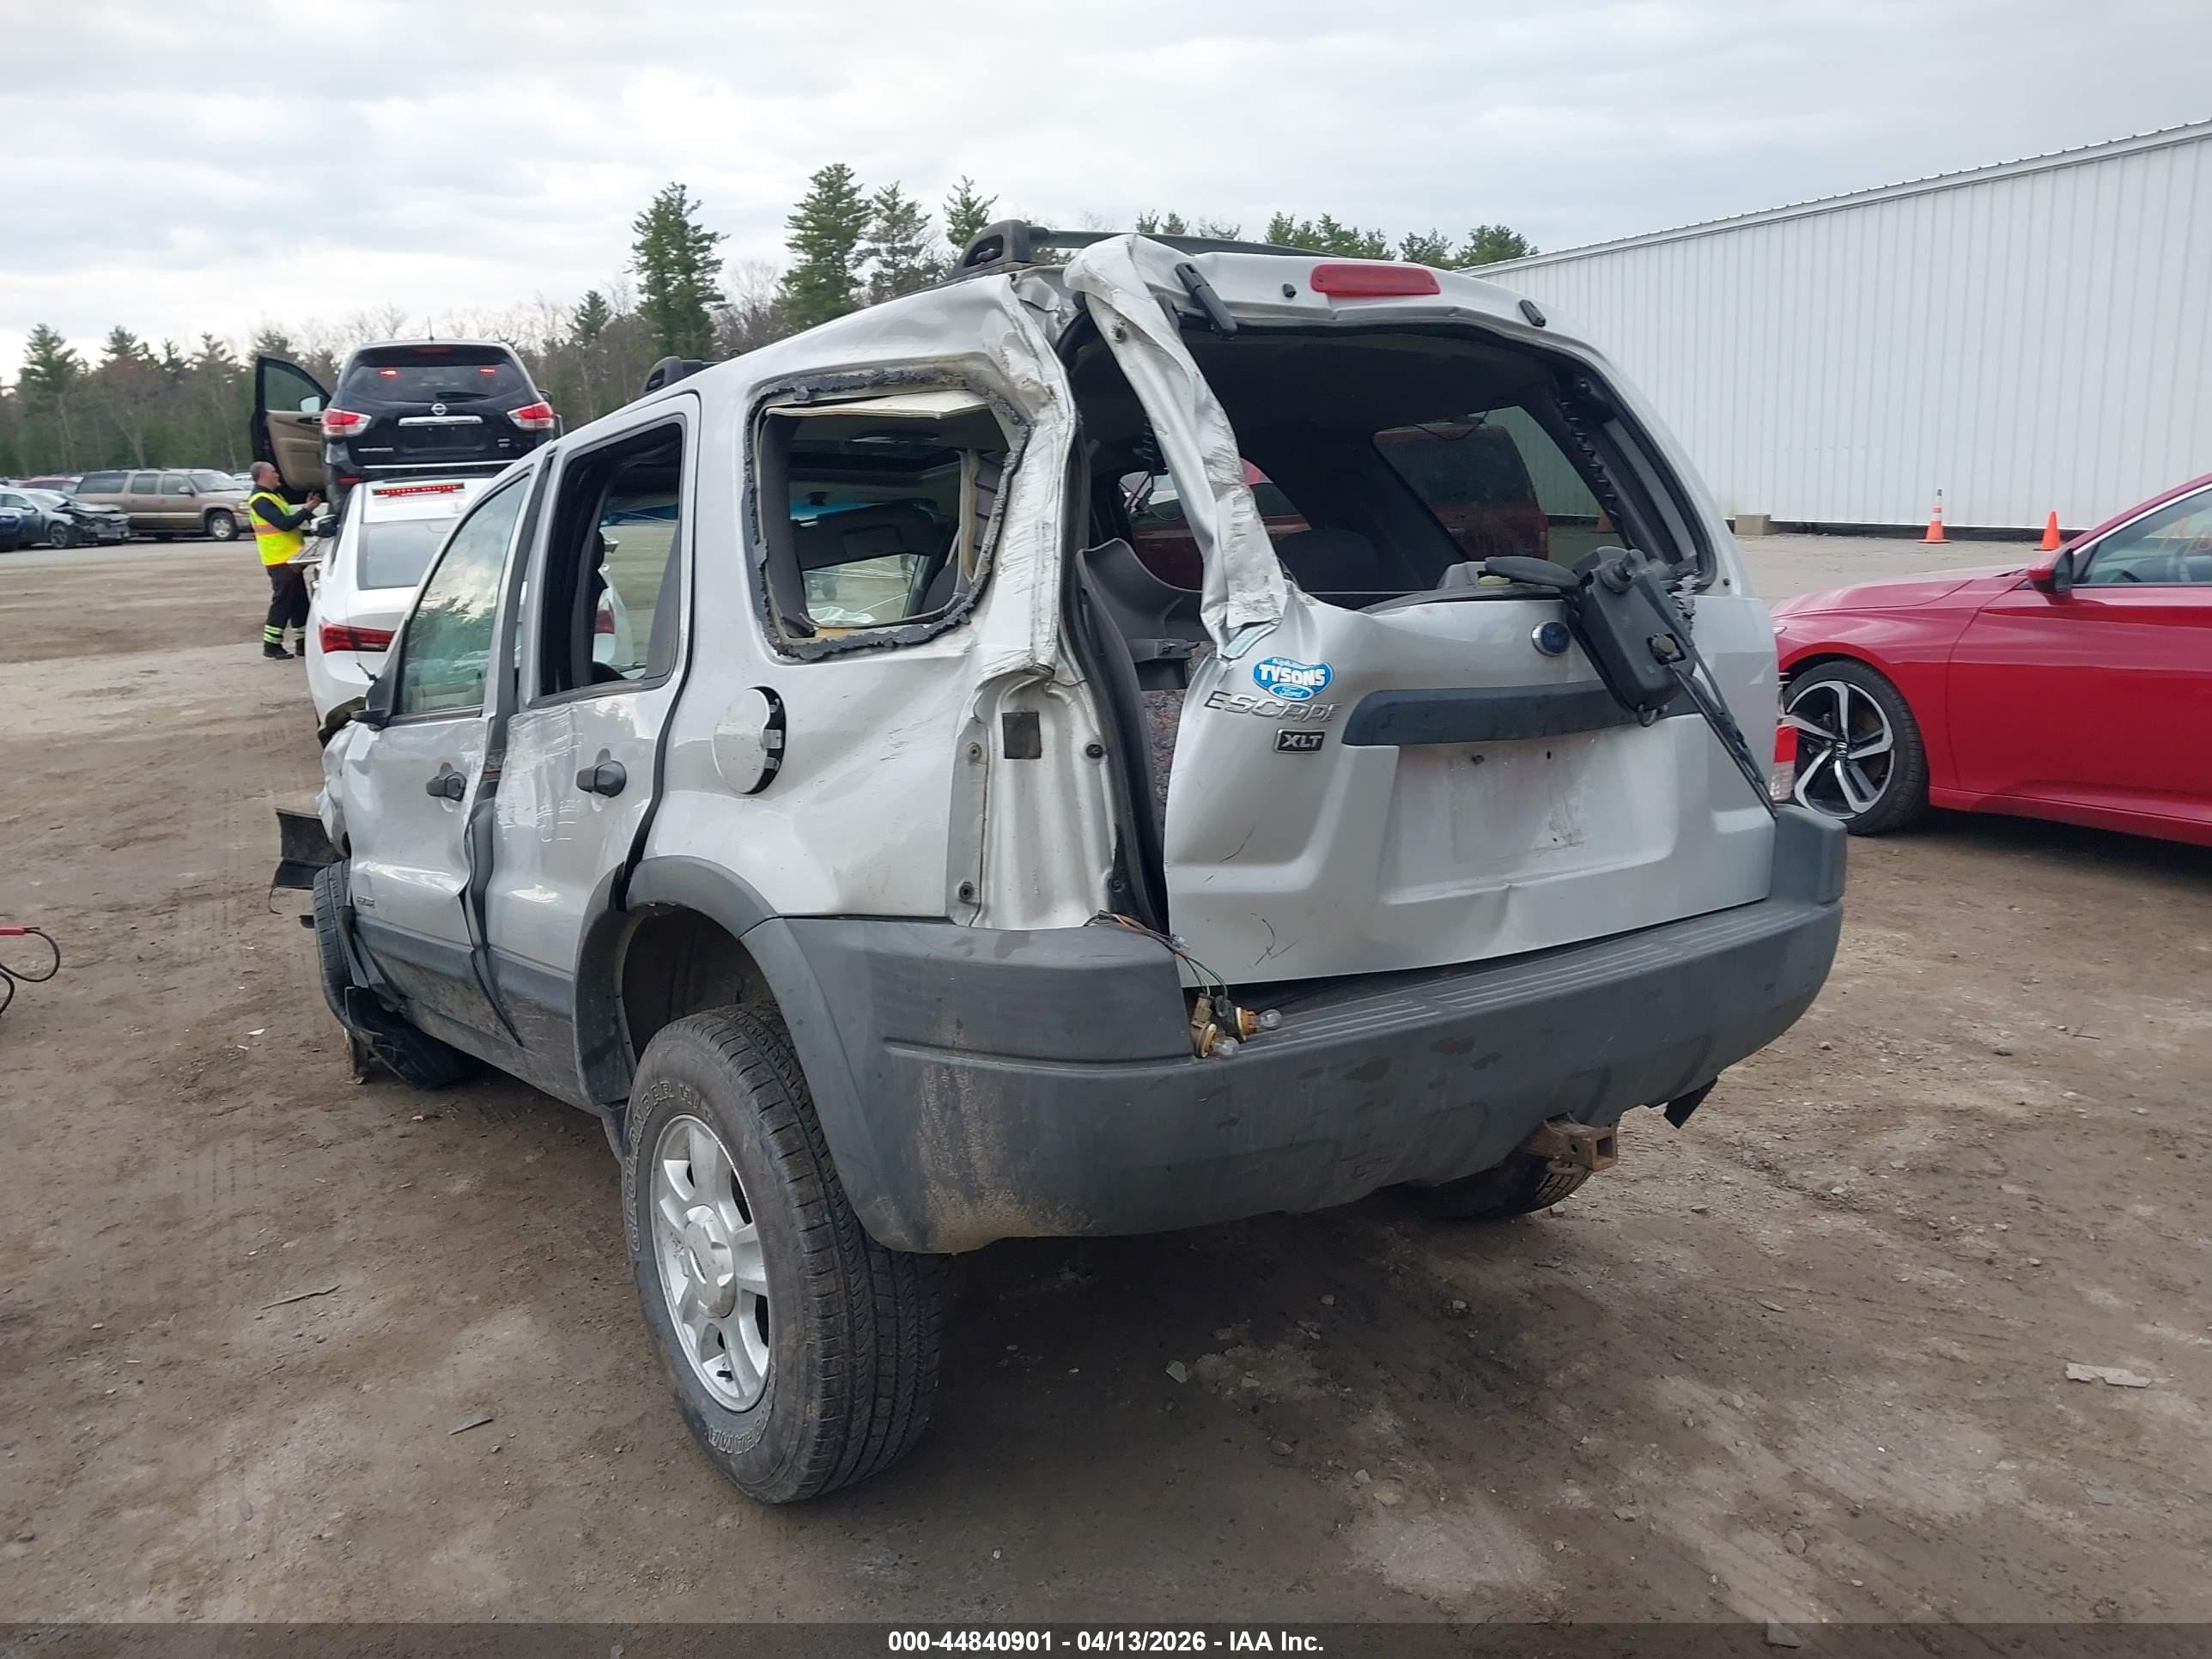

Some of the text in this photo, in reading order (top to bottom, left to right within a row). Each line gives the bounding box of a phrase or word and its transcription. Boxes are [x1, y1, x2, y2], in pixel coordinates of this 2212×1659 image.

[1258, 664, 1326, 687] TYSONS
[1279, 686, 1304, 698] Ford
[1204, 690, 1342, 723] ESCAPE
[1281, 734, 1322, 748] XLT
[625, 1079, 676, 1252] GEOLANDAR
